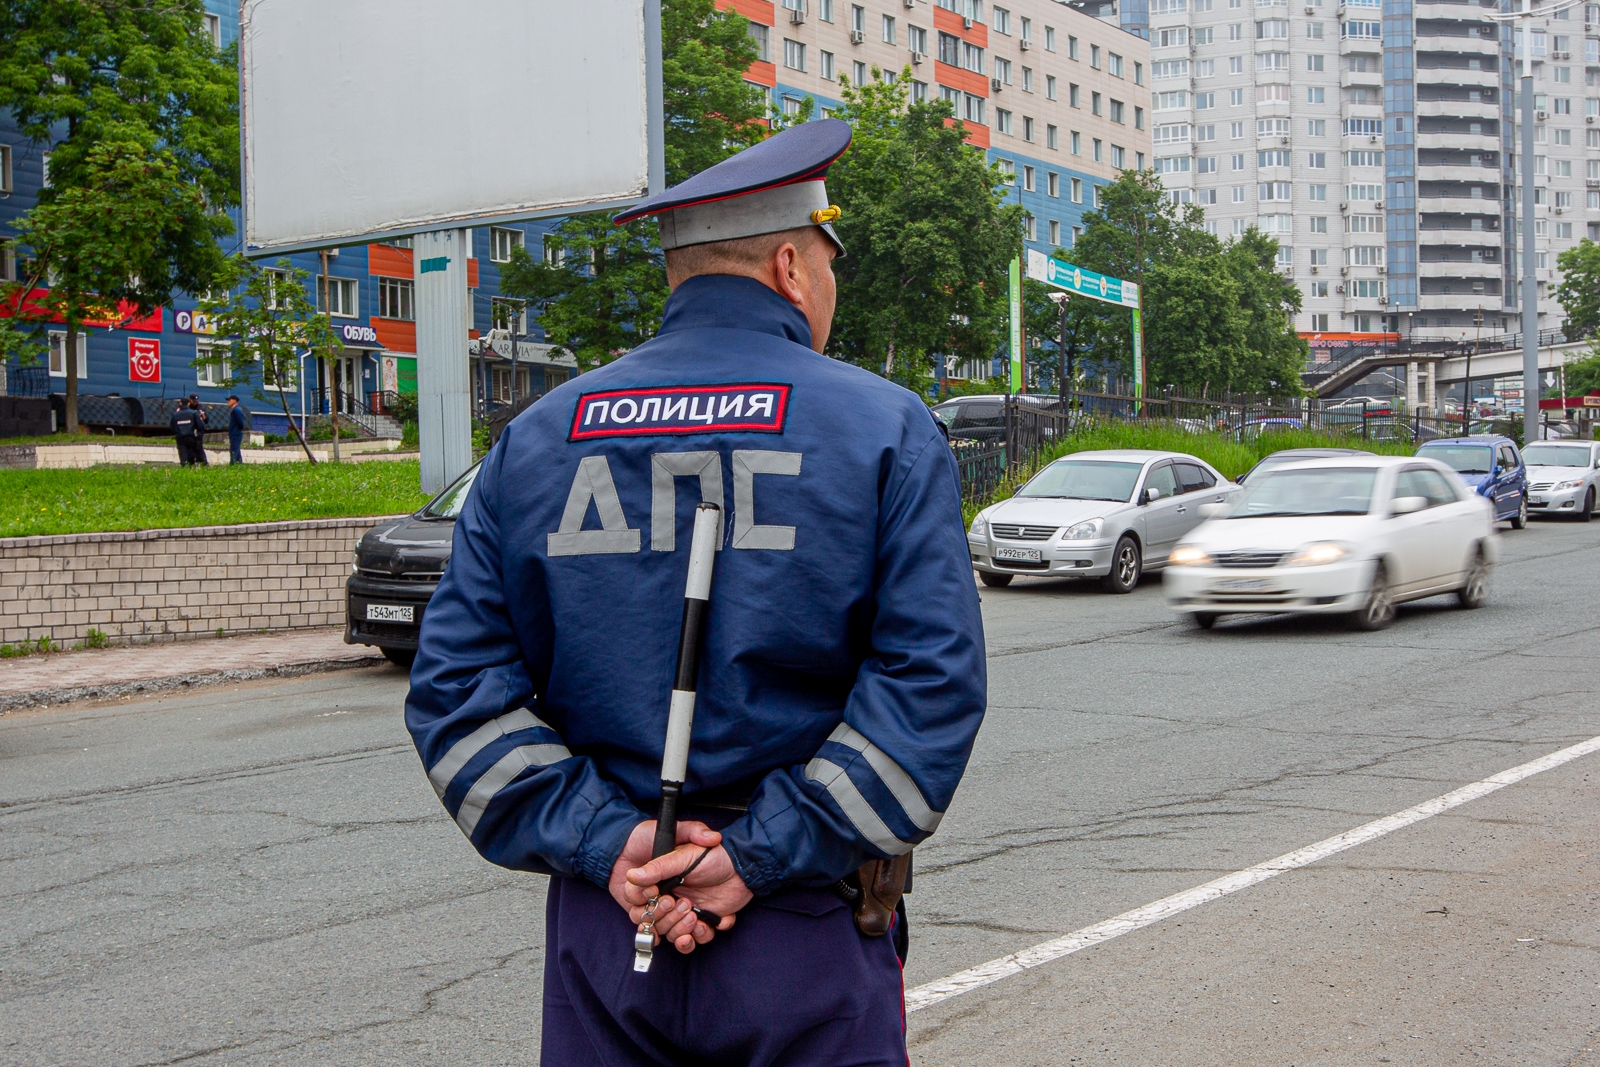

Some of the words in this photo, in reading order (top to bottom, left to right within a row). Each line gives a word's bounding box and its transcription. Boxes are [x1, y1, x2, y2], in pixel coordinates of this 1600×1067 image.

[343, 325, 377, 341] ОБУВЬ
[498, 343, 530, 357] ARVIA
[584, 393, 774, 426] ПОЛИЦИЯ
[547, 449, 803, 557] ДПС
[369, 606, 398, 619] Т543МТ
[399, 607, 412, 617] 125
